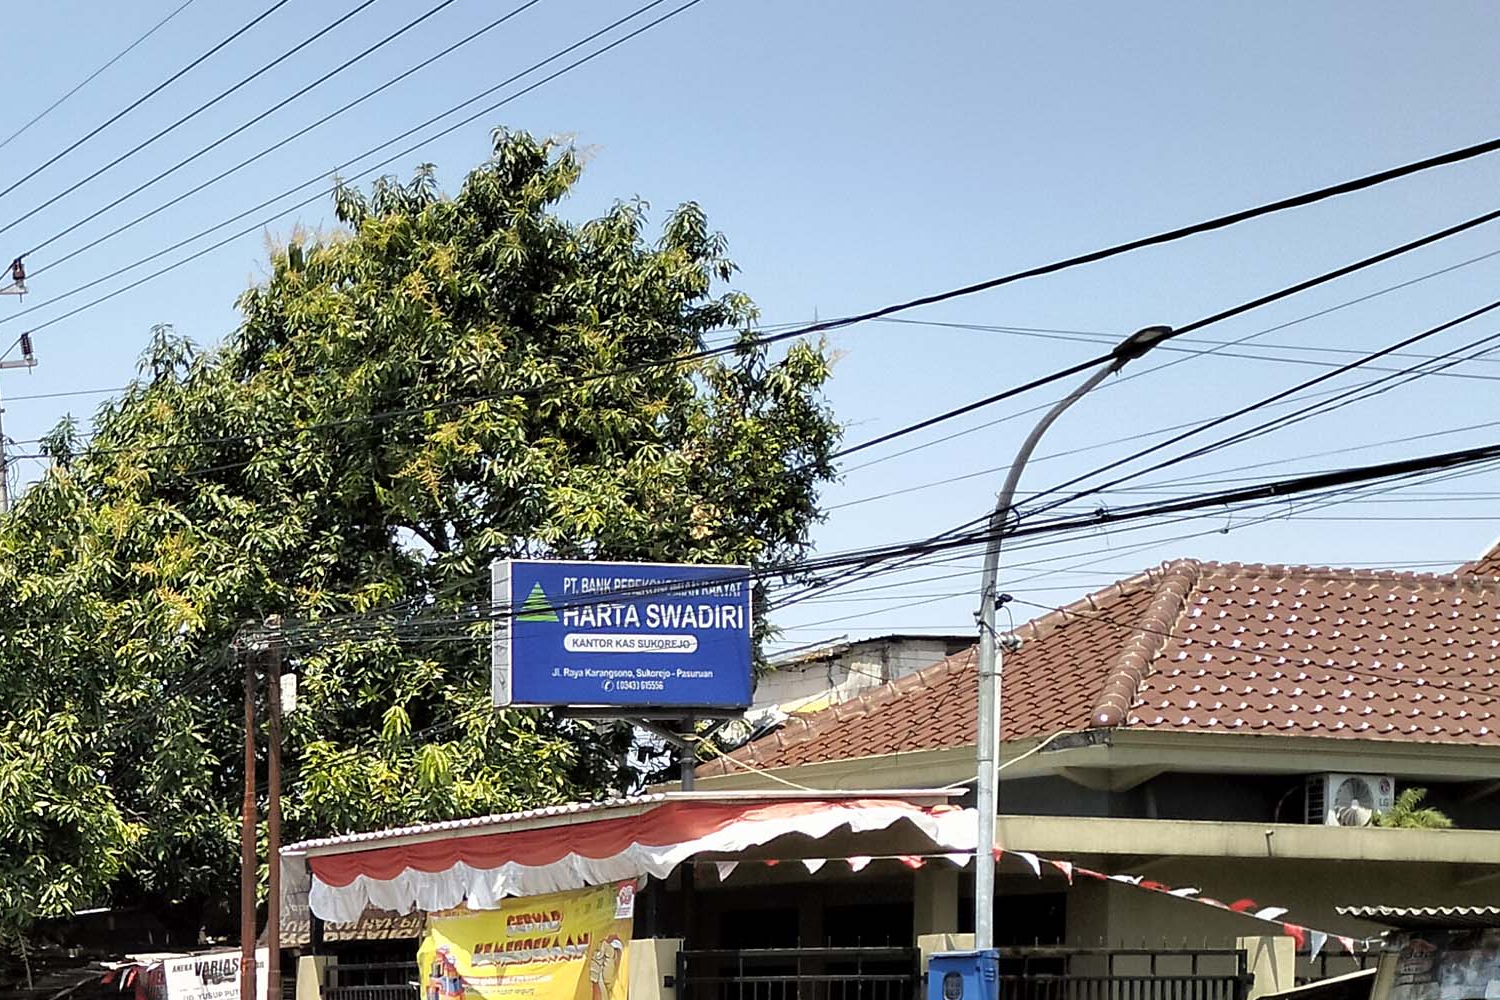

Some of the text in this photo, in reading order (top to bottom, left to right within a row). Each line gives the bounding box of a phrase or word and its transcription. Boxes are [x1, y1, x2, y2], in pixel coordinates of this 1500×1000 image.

[563, 577, 579, 595] PT.
[581, 577, 611, 595] BANK
[563, 603, 743, 629] HARTA SWADIRI
[572, 638, 690, 649] KANTOR KAS SUKOREJO
[564, 668, 583, 679] Raya
[585, 668, 635, 679] Karangsono,
[636, 668, 671, 680] Sukorejo
[677, 668, 713, 678] Pasuruan
[195, 957, 240, 977] VARIAS
